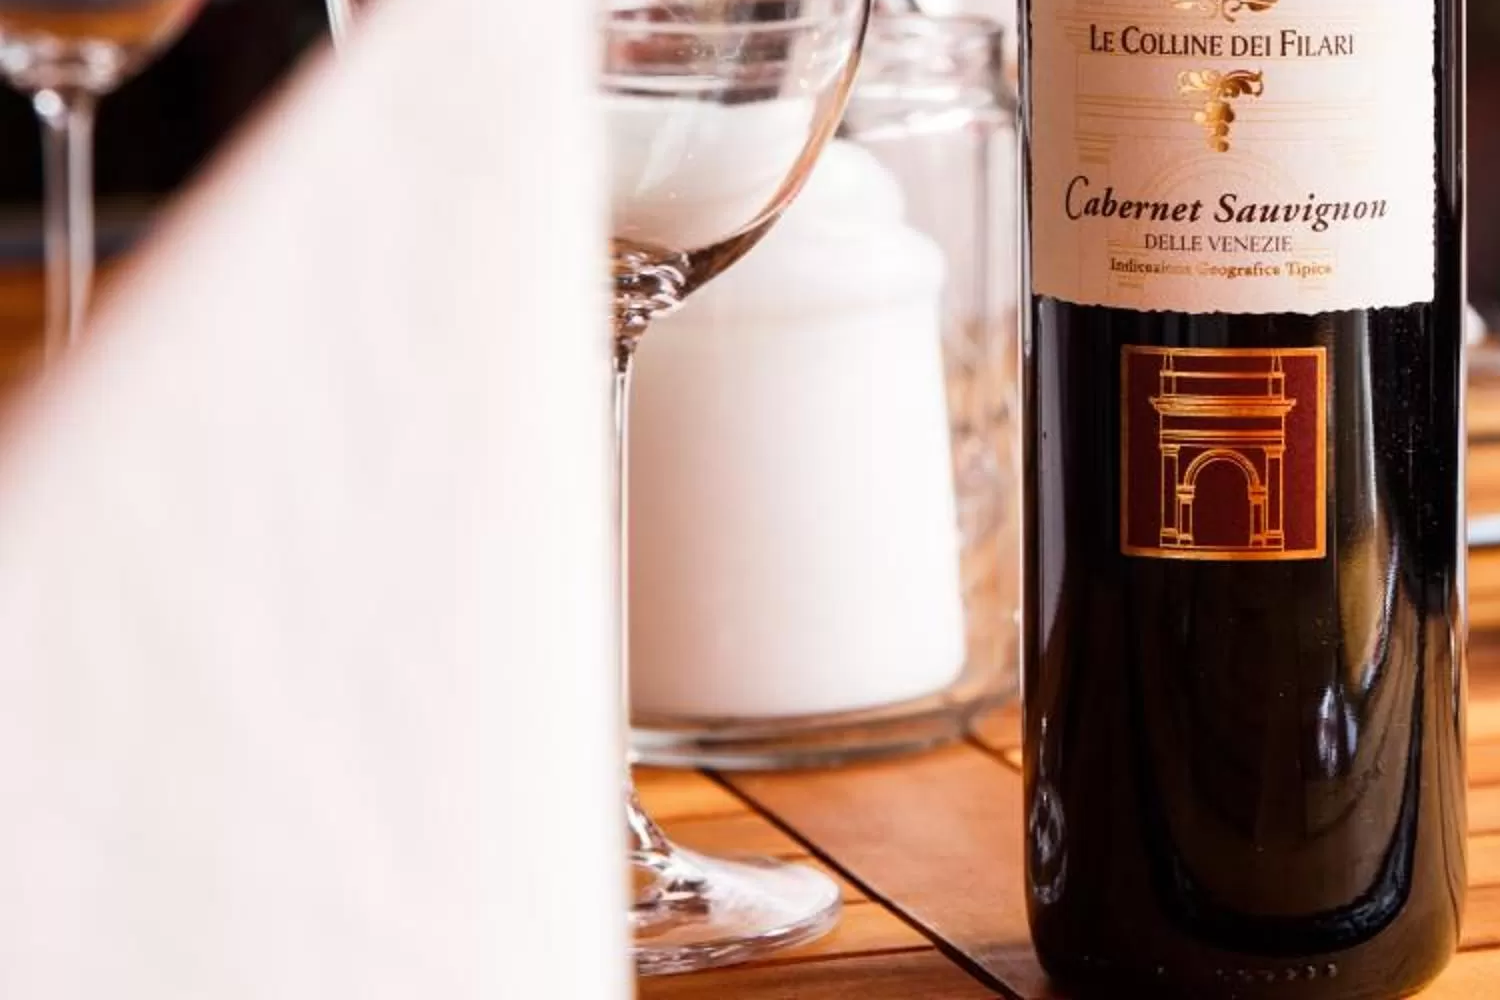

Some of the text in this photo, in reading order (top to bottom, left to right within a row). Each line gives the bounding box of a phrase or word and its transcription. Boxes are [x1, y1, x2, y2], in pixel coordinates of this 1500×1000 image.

[1089, 23, 1353, 57] LE COLLINE DEI FILARI
[1065, 175, 1388, 232] Cabernet Sauvignon
[1145, 233, 1293, 253] DELLE VENEZIE
